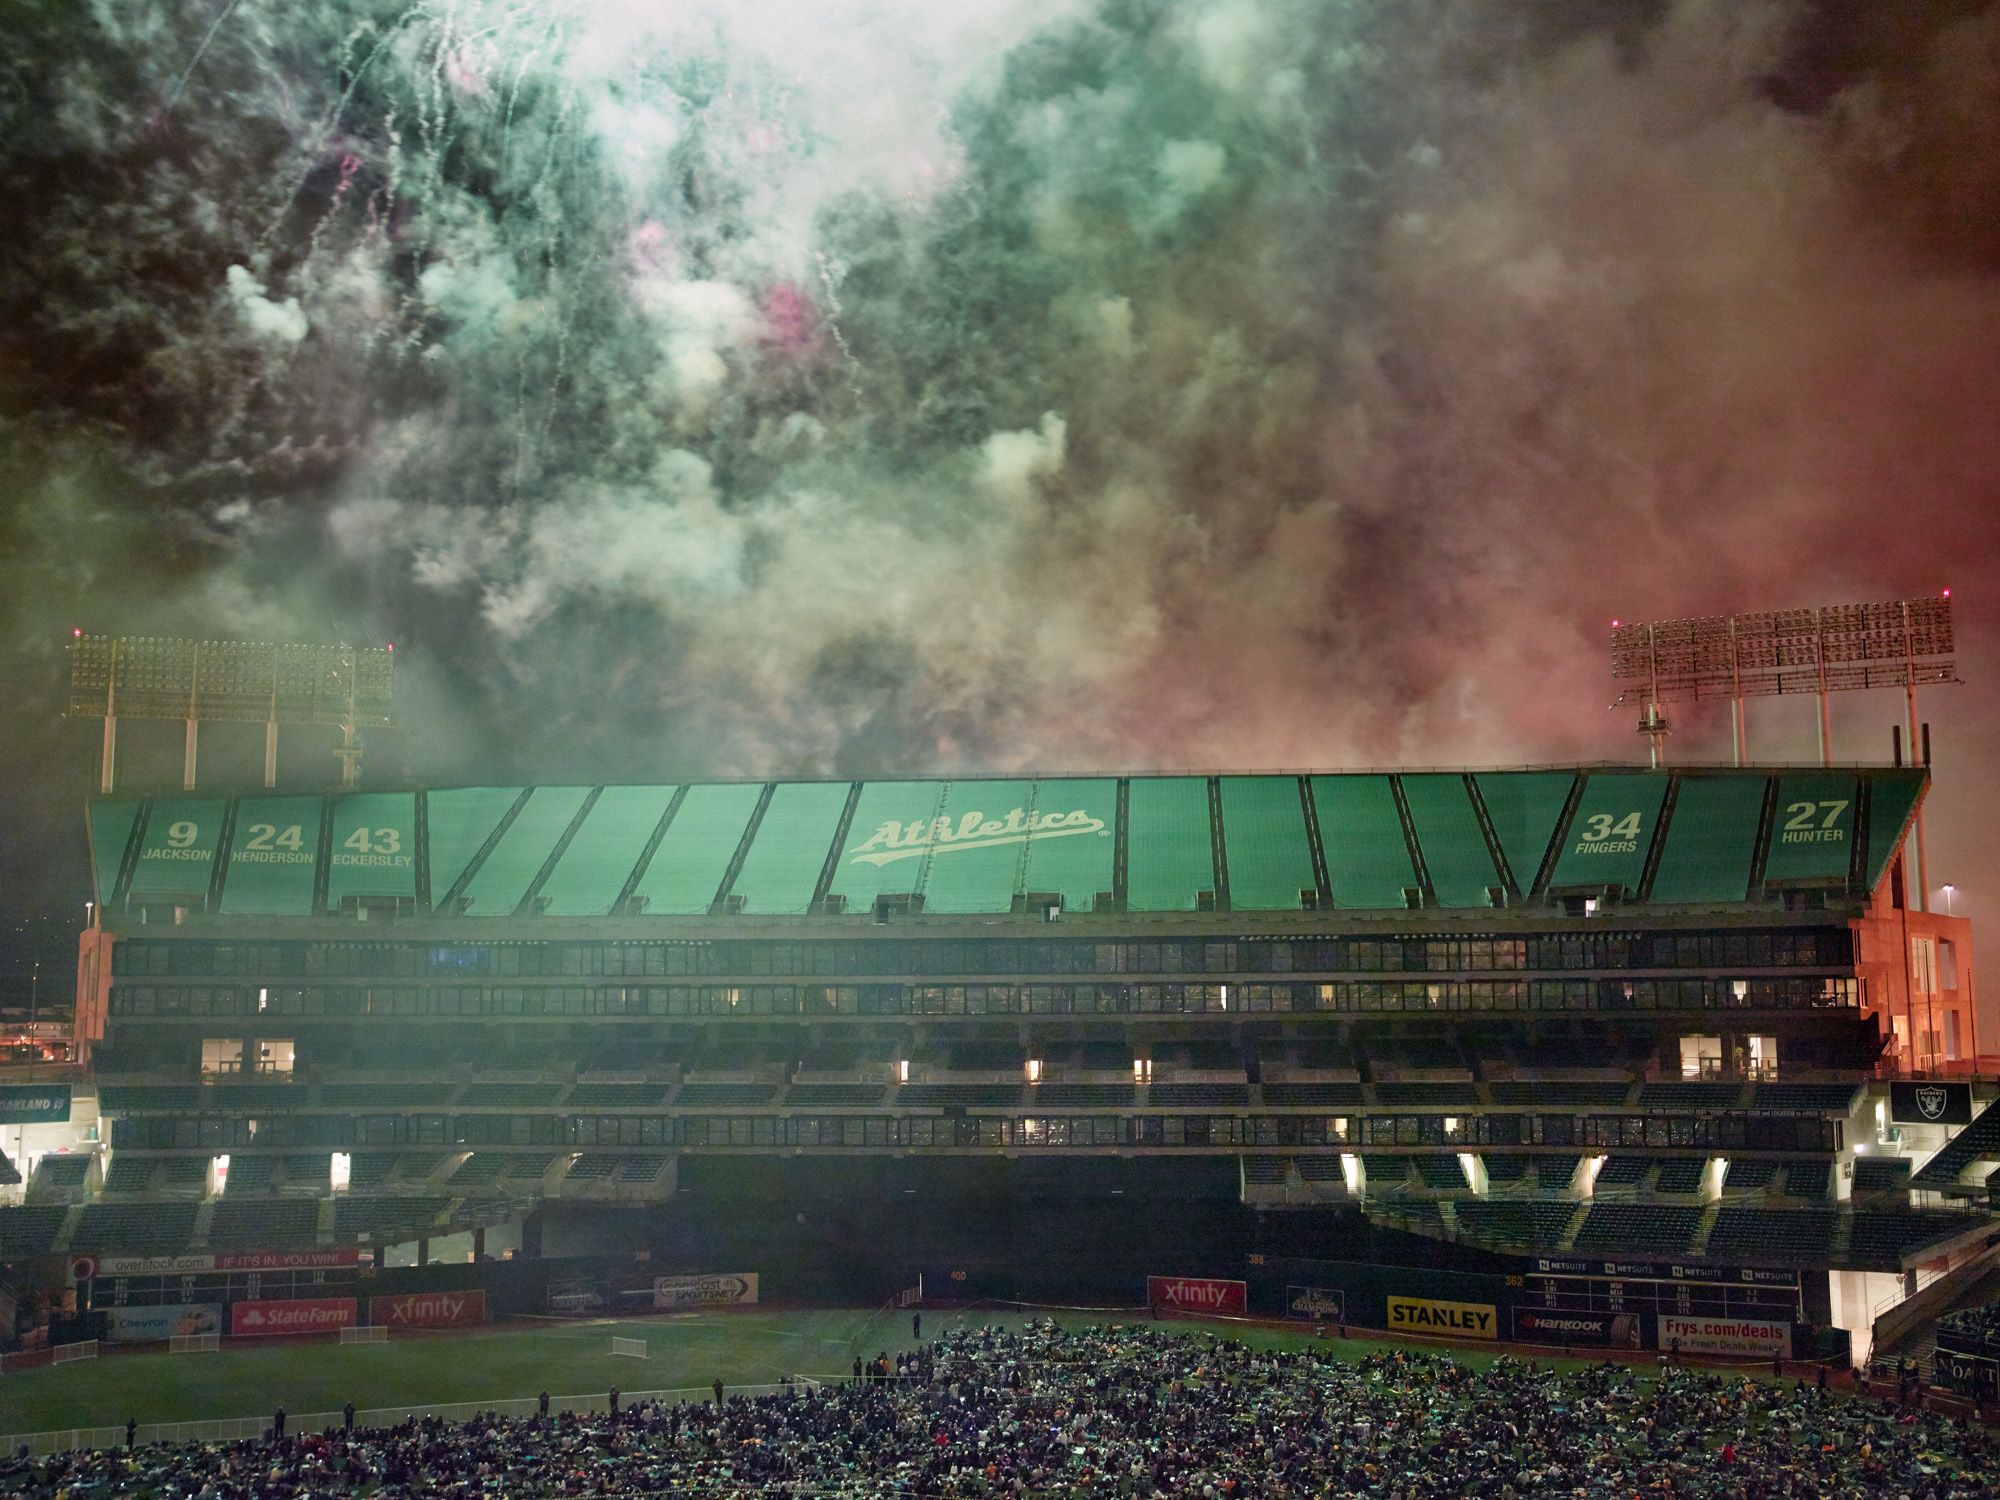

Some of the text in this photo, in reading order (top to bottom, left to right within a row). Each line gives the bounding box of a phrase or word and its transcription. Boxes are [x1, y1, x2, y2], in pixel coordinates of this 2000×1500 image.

[1785, 800, 1849, 830] 27
[167, 821, 198, 848] 9
[1582, 812, 1642, 841] 34
[246, 824, 304, 850] 24
[344, 827, 401, 854] 43
[850, 808, 1104, 867] Athletics
[1782, 829, 1844, 843] HUNTER
[142, 847, 212, 861] JACKSON
[1574, 841, 1638, 854] FINGERS
[232, 851, 314, 864] HENDERSON
[331, 854, 413, 867] ECKERSLEY
[223, 1257, 233, 1267] IF
[283, 1255, 310, 1265] YOU
[1618, 1265, 1653, 1273] NETSUITE
[1685, 1268, 1721, 1276] NETSUITE
[1755, 1272, 1793, 1280] NETSUITE
[1505, 1275, 1524, 1287] 362
[1165, 1281, 1228, 1307] xfinity
[392, 1297, 465, 1323] xfinity
[1393, 1304, 1490, 1330] STANLEY
[1665, 1320, 1783, 1339] Frys.com/deals
